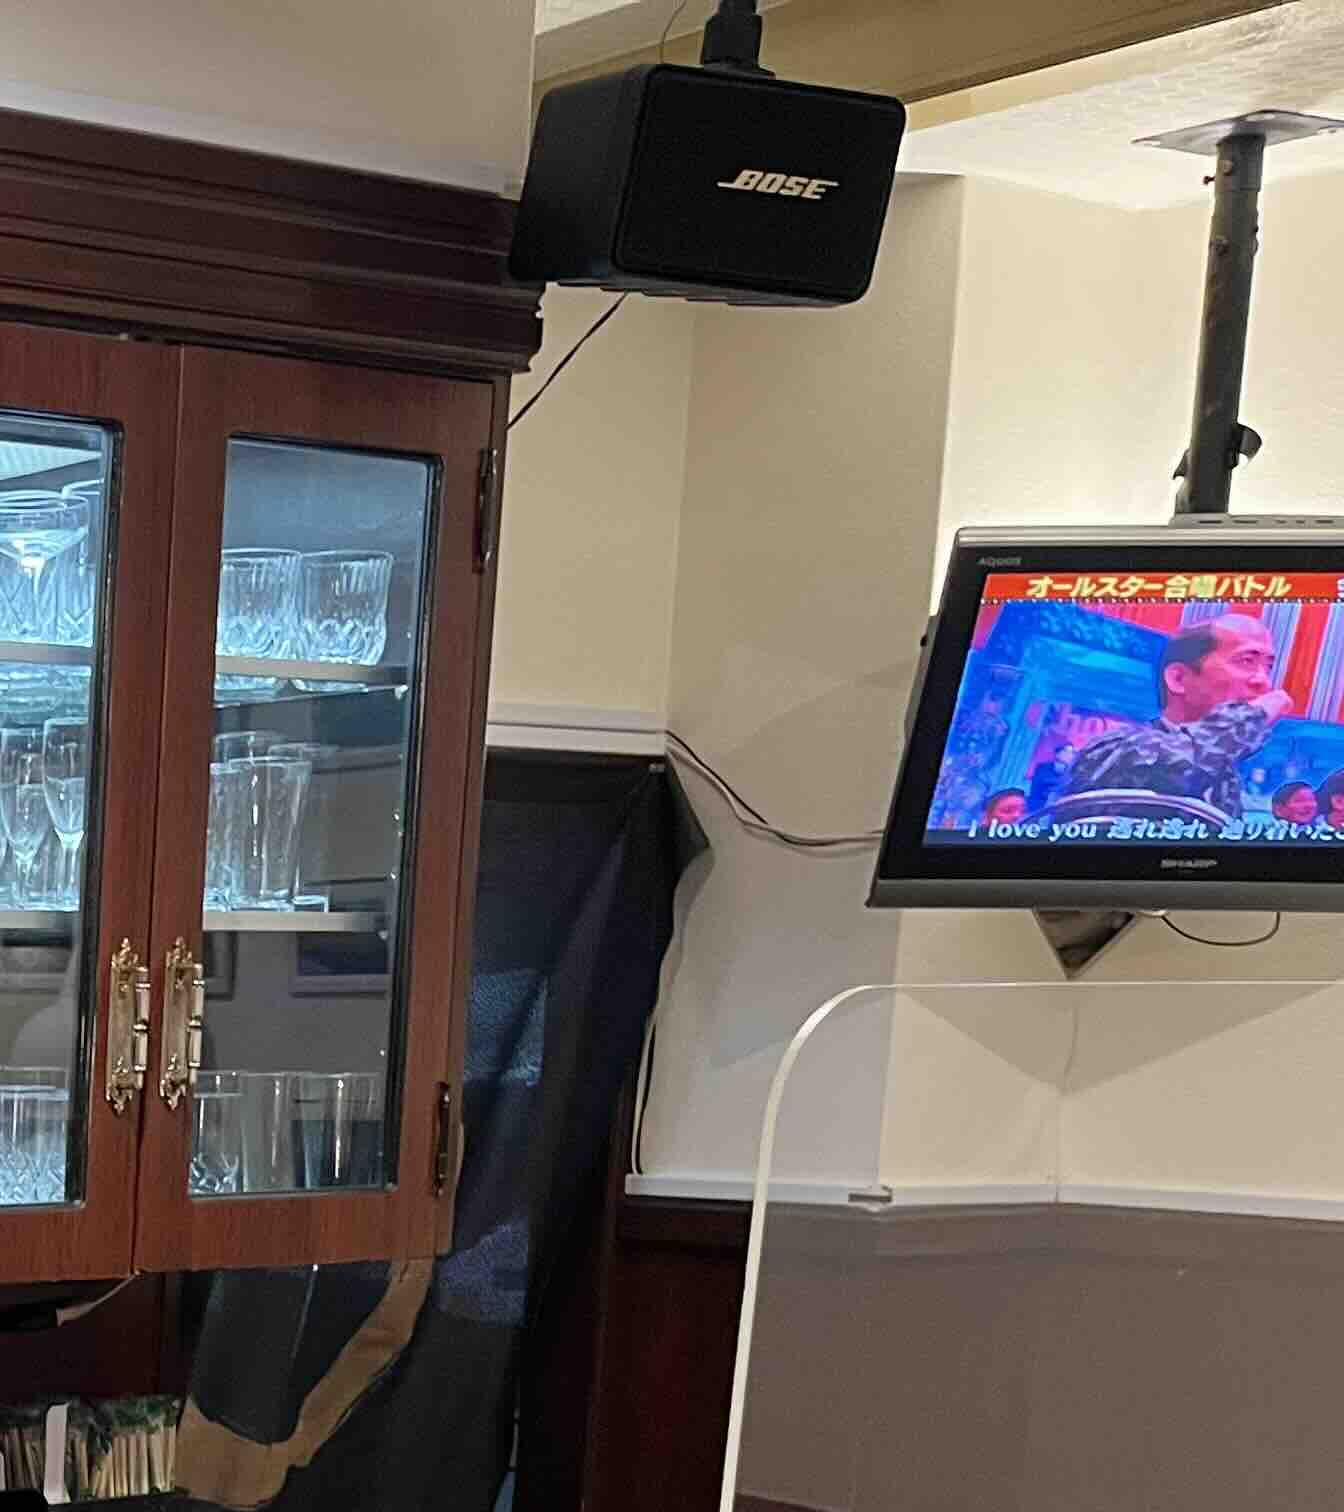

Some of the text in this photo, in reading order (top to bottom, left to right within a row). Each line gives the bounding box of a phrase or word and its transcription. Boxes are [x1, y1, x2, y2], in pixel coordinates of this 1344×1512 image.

[717, 169, 840, 199] BOSE
[988, 818, 1040, 839] love
[1049, 821, 1097, 842] you
